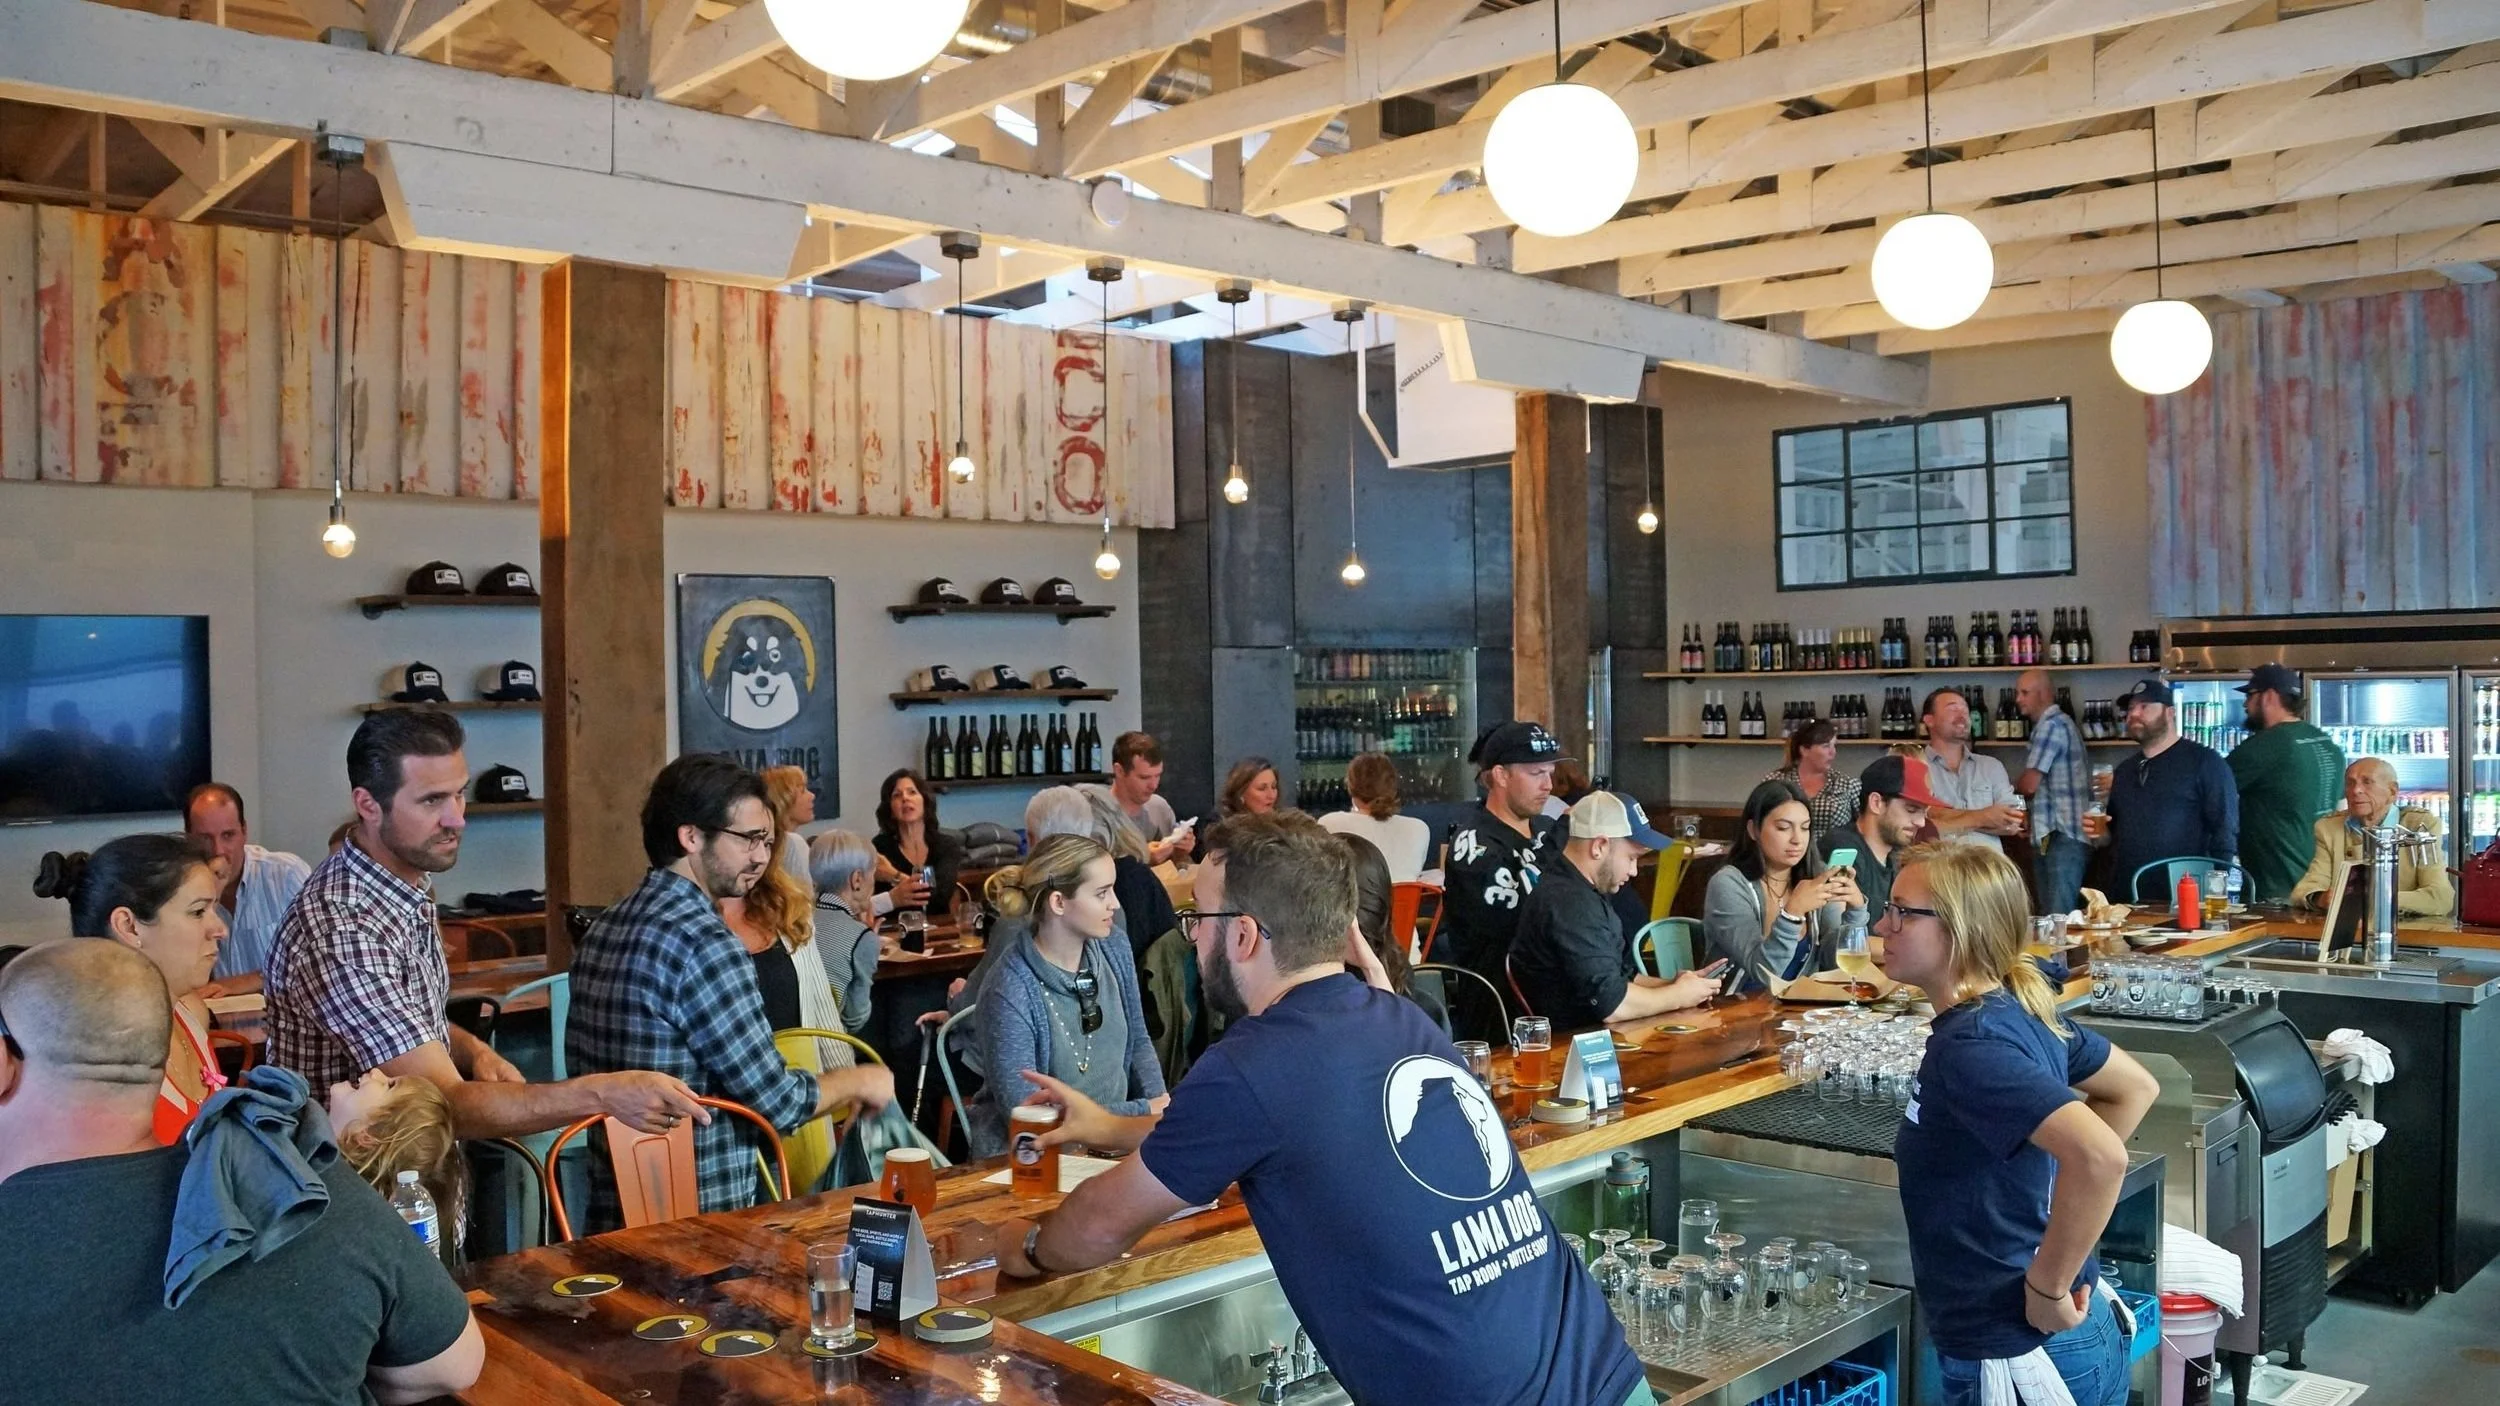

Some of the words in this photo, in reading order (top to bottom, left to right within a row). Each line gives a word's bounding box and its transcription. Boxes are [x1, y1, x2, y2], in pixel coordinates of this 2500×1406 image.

[1431, 1205, 1510, 1275] LAMA
[1501, 1190, 1543, 1242] DOG
[1449, 1274, 1473, 1295] TAP
[1472, 1260, 1502, 1287] ROOM
[1507, 1243, 1535, 1270] BOTTLE
